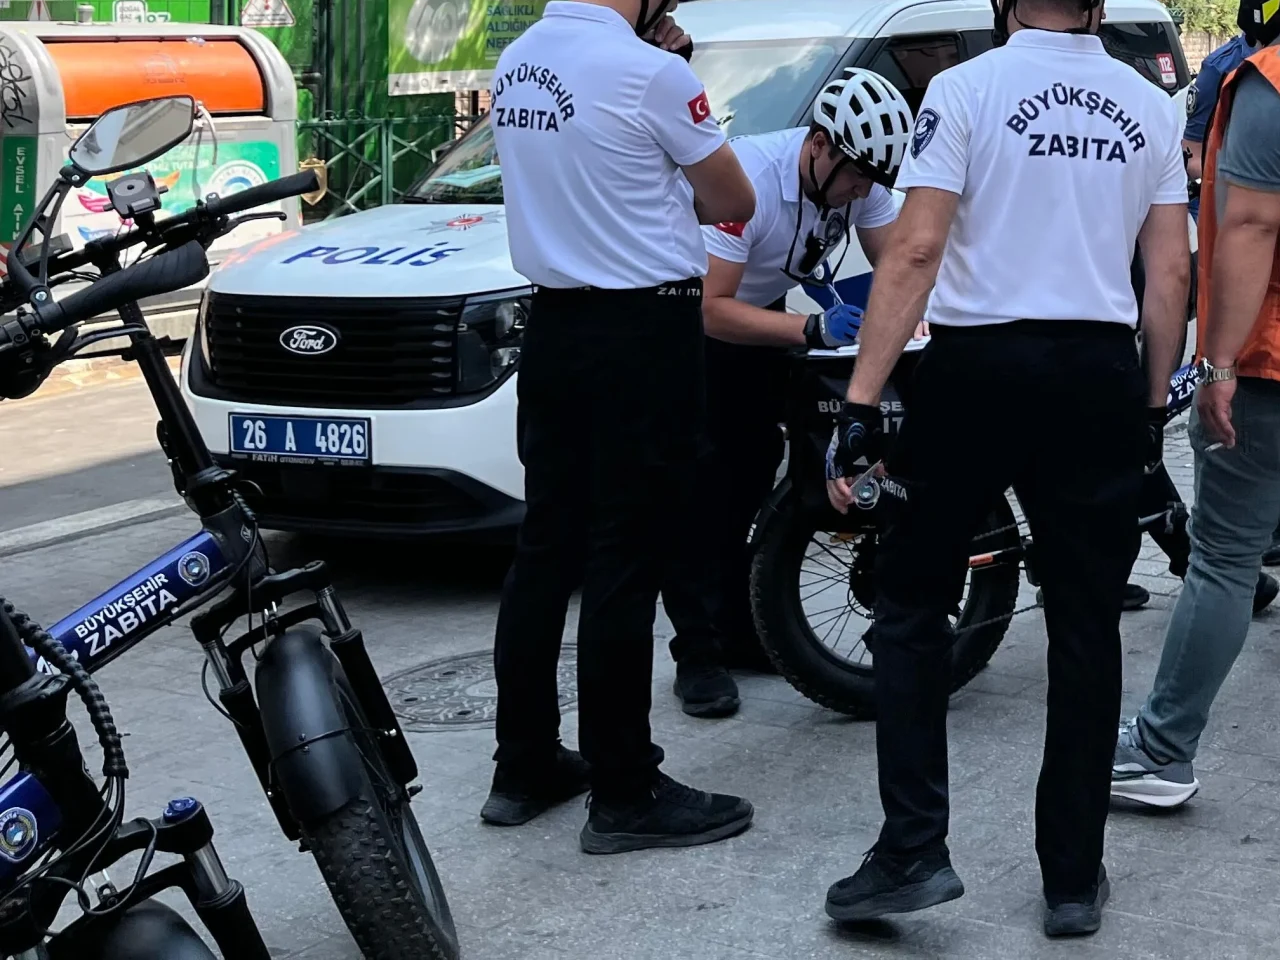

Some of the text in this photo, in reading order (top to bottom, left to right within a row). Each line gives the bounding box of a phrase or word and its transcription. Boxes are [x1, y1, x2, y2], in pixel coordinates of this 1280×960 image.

[1159, 56, 1173, 72] 112
[496, 107, 559, 133] ZABITA
[1006, 82, 1146, 153] BÜYÜKŞEHİR
[1028, 133, 1127, 163] ZABITA
[15, 146, 26, 193] EVSEL
[280, 242, 465, 267] POLİS
[289, 329, 325, 350] Ford
[243, 419, 365, 454] 26 A 4826
[880, 475, 908, 502] ZABITA
[74, 572, 169, 639] BÜYÜKŞEHİR
[84, 589, 178, 657] ZABITA
